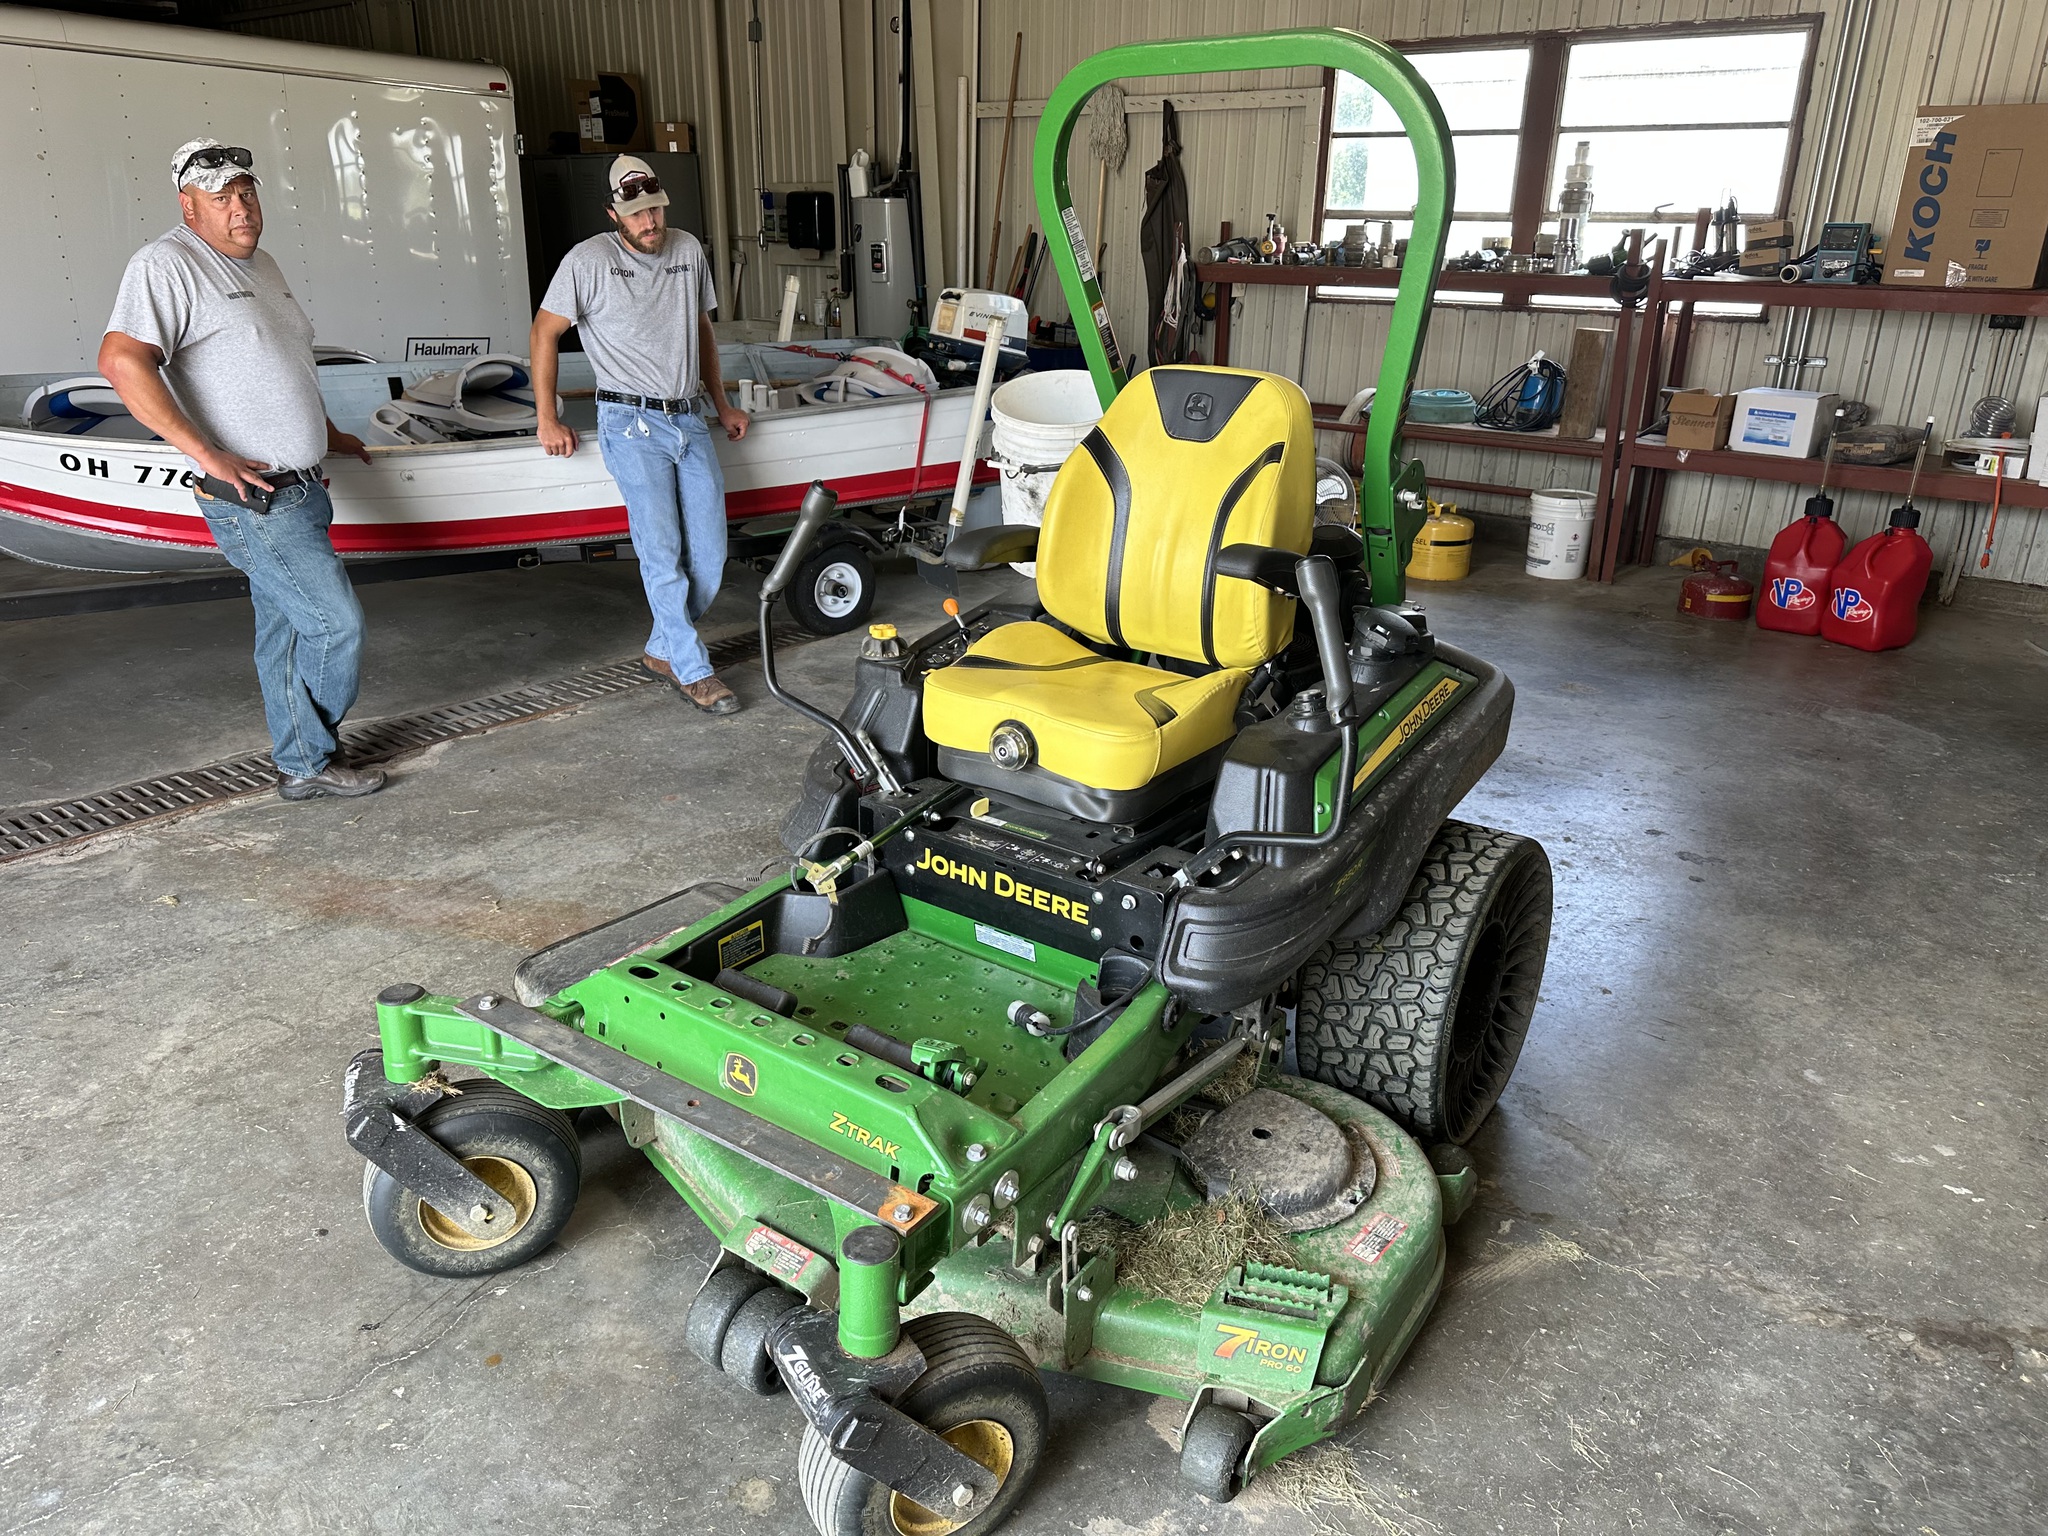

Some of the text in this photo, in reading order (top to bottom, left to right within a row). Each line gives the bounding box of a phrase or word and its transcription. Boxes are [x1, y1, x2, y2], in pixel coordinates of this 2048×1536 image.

[1903, 131, 1957, 262] KOCH
[1967, 263, 1988, 271] FRAGILE
[414, 342, 479, 356] Haulmark
[1672, 415, 1716, 429] Stenner
[59, 453, 109, 478] OH
[1413, 538, 1427, 546] SEL
[1773, 578, 1804, 608] VP
[1835, 588, 1860, 619] VP
[1399, 683, 1451, 743] JOHN DEERE
[916, 848, 1090, 926] JOHN DEERE
[1442, 989, 1459, 1046] MICHELIN
[1259, 1358, 1302, 1374] PRO 60
